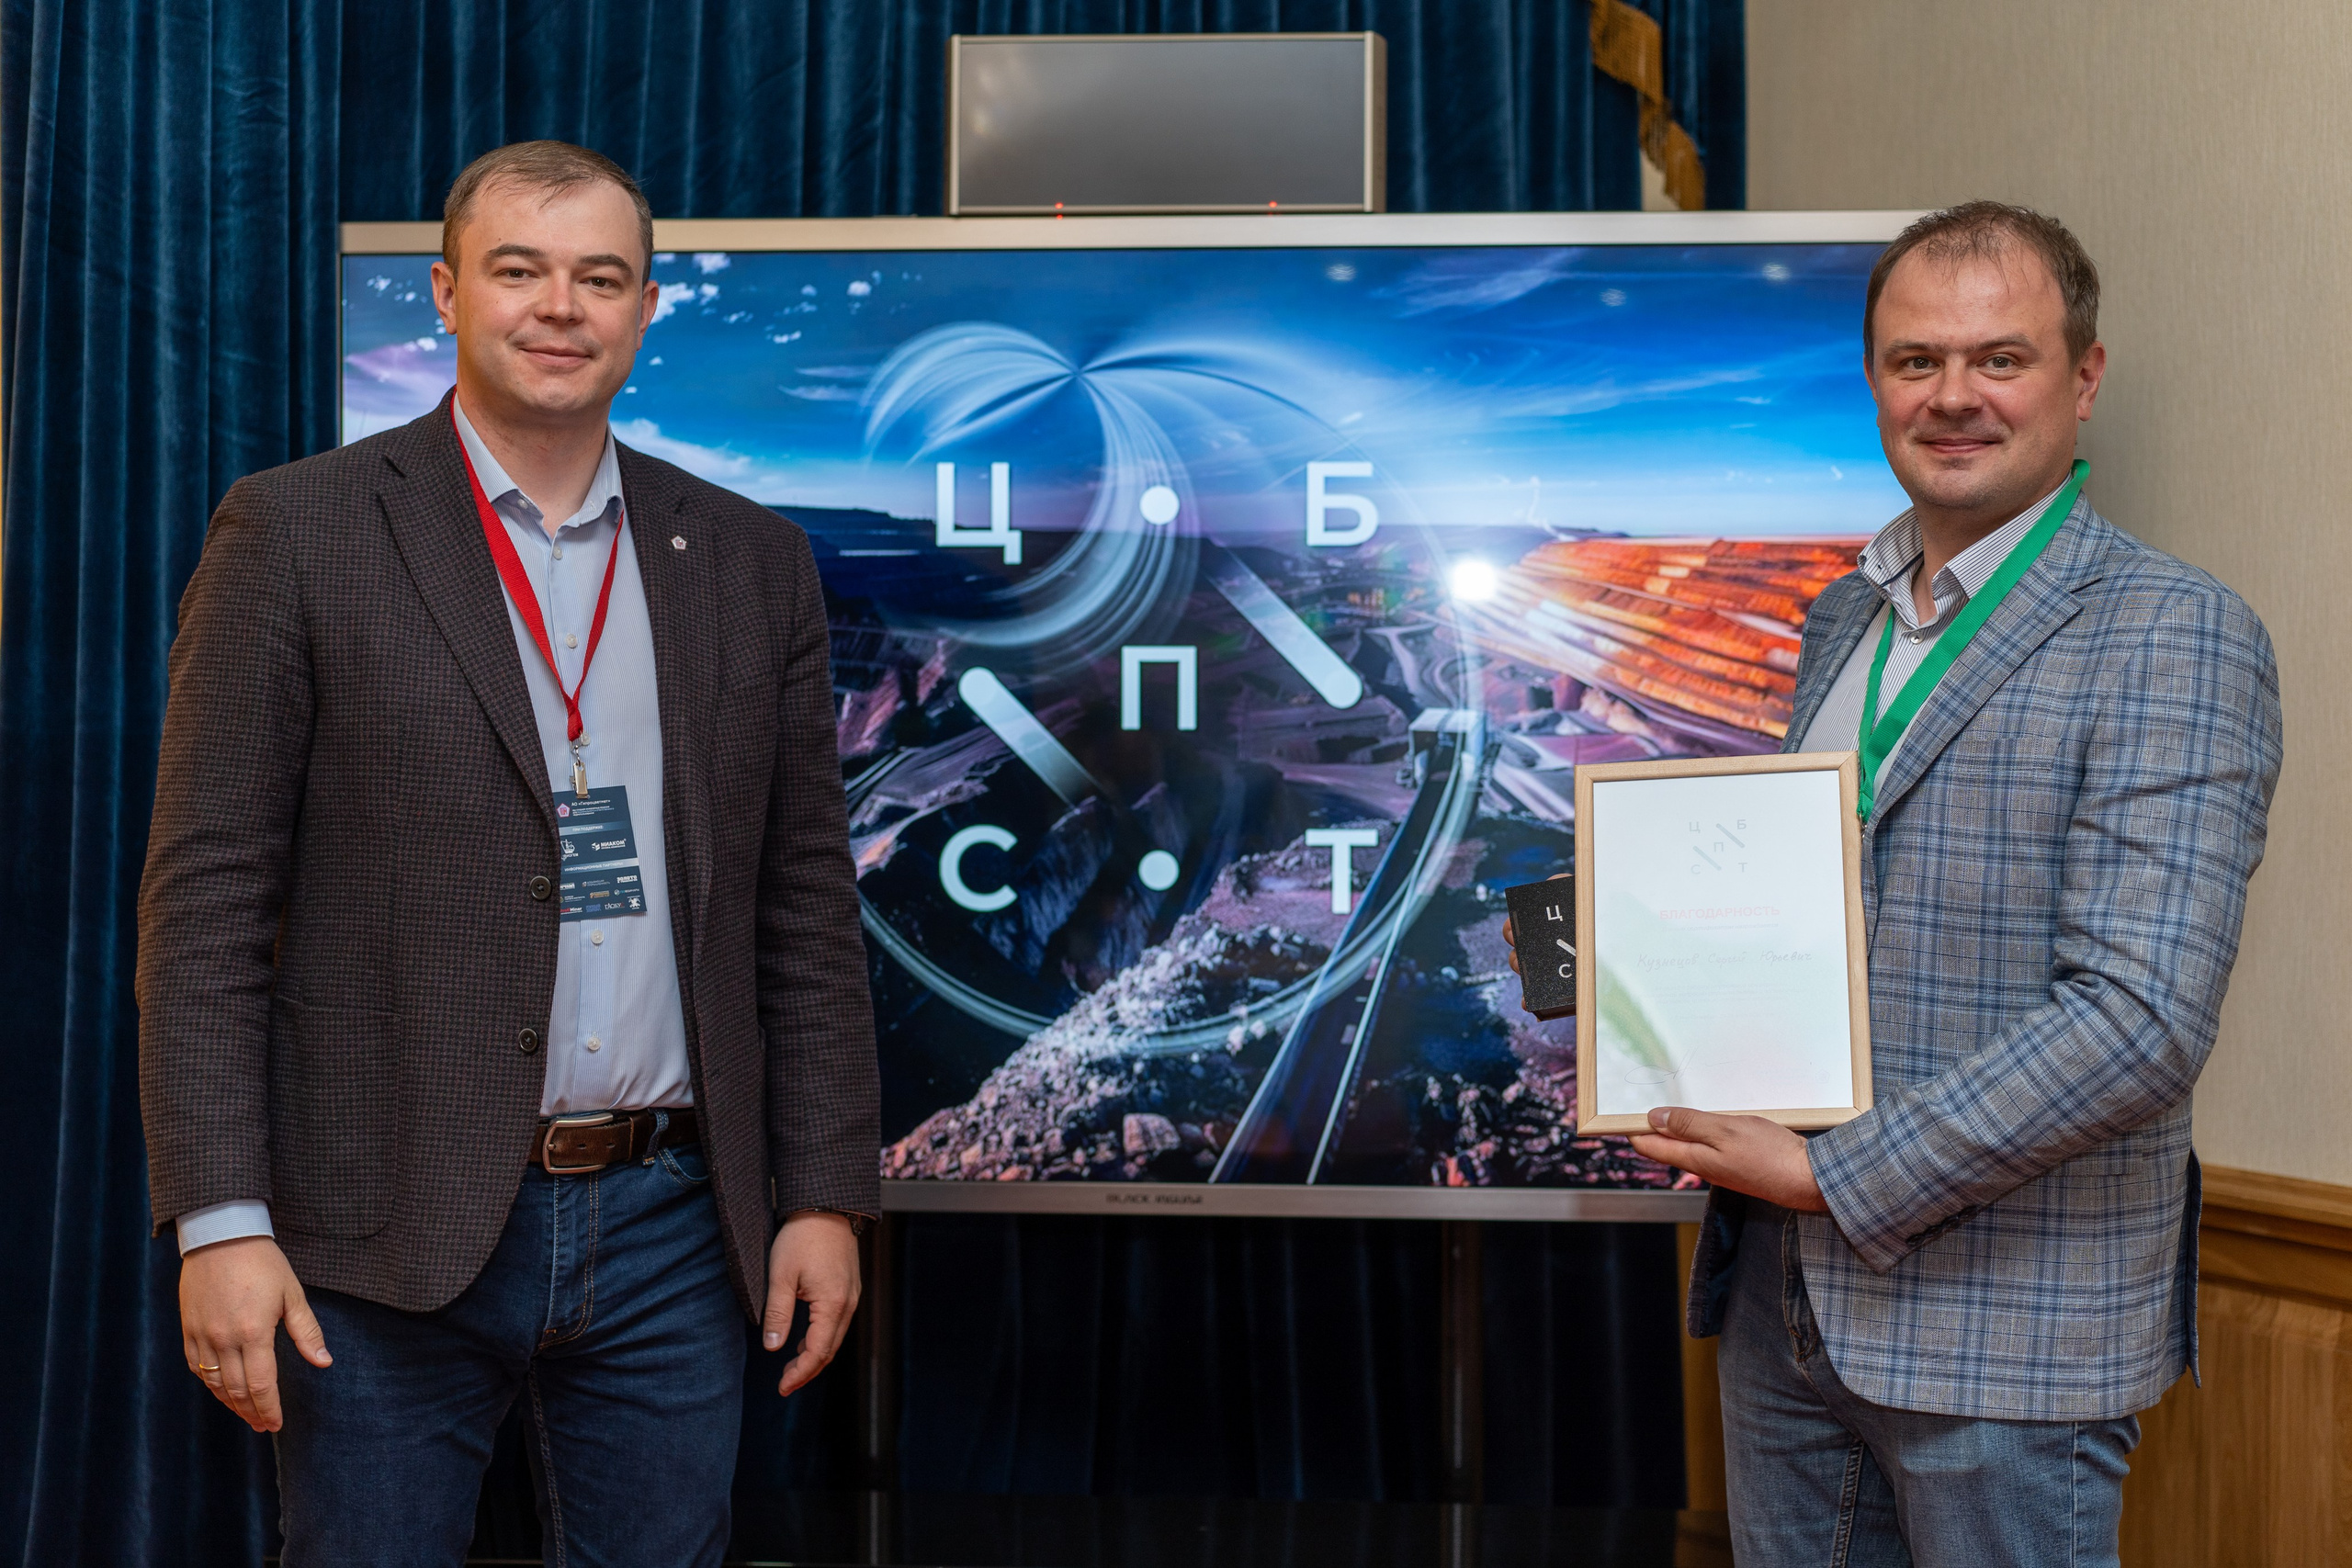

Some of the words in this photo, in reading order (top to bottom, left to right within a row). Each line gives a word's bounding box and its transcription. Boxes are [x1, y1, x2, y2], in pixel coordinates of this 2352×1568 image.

[936, 462, 1022, 564] Ц
[1306, 462, 1378, 547] Б
[1121, 646, 1197, 730] П
[1689, 821, 1701, 834] Ц
[1736, 818, 1747, 829] Б
[1713, 841, 1724, 852] П
[939, 825, 1018, 912] С
[1306, 829, 1378, 914] Т
[1690, 863, 1701, 874] С
[1737, 862, 1747, 873] Т
[1545, 905, 1564, 922] Ц
[1659, 906, 1781, 920] БЛАГОДАРНОСТЬ
[1558, 964, 1573, 978] С
